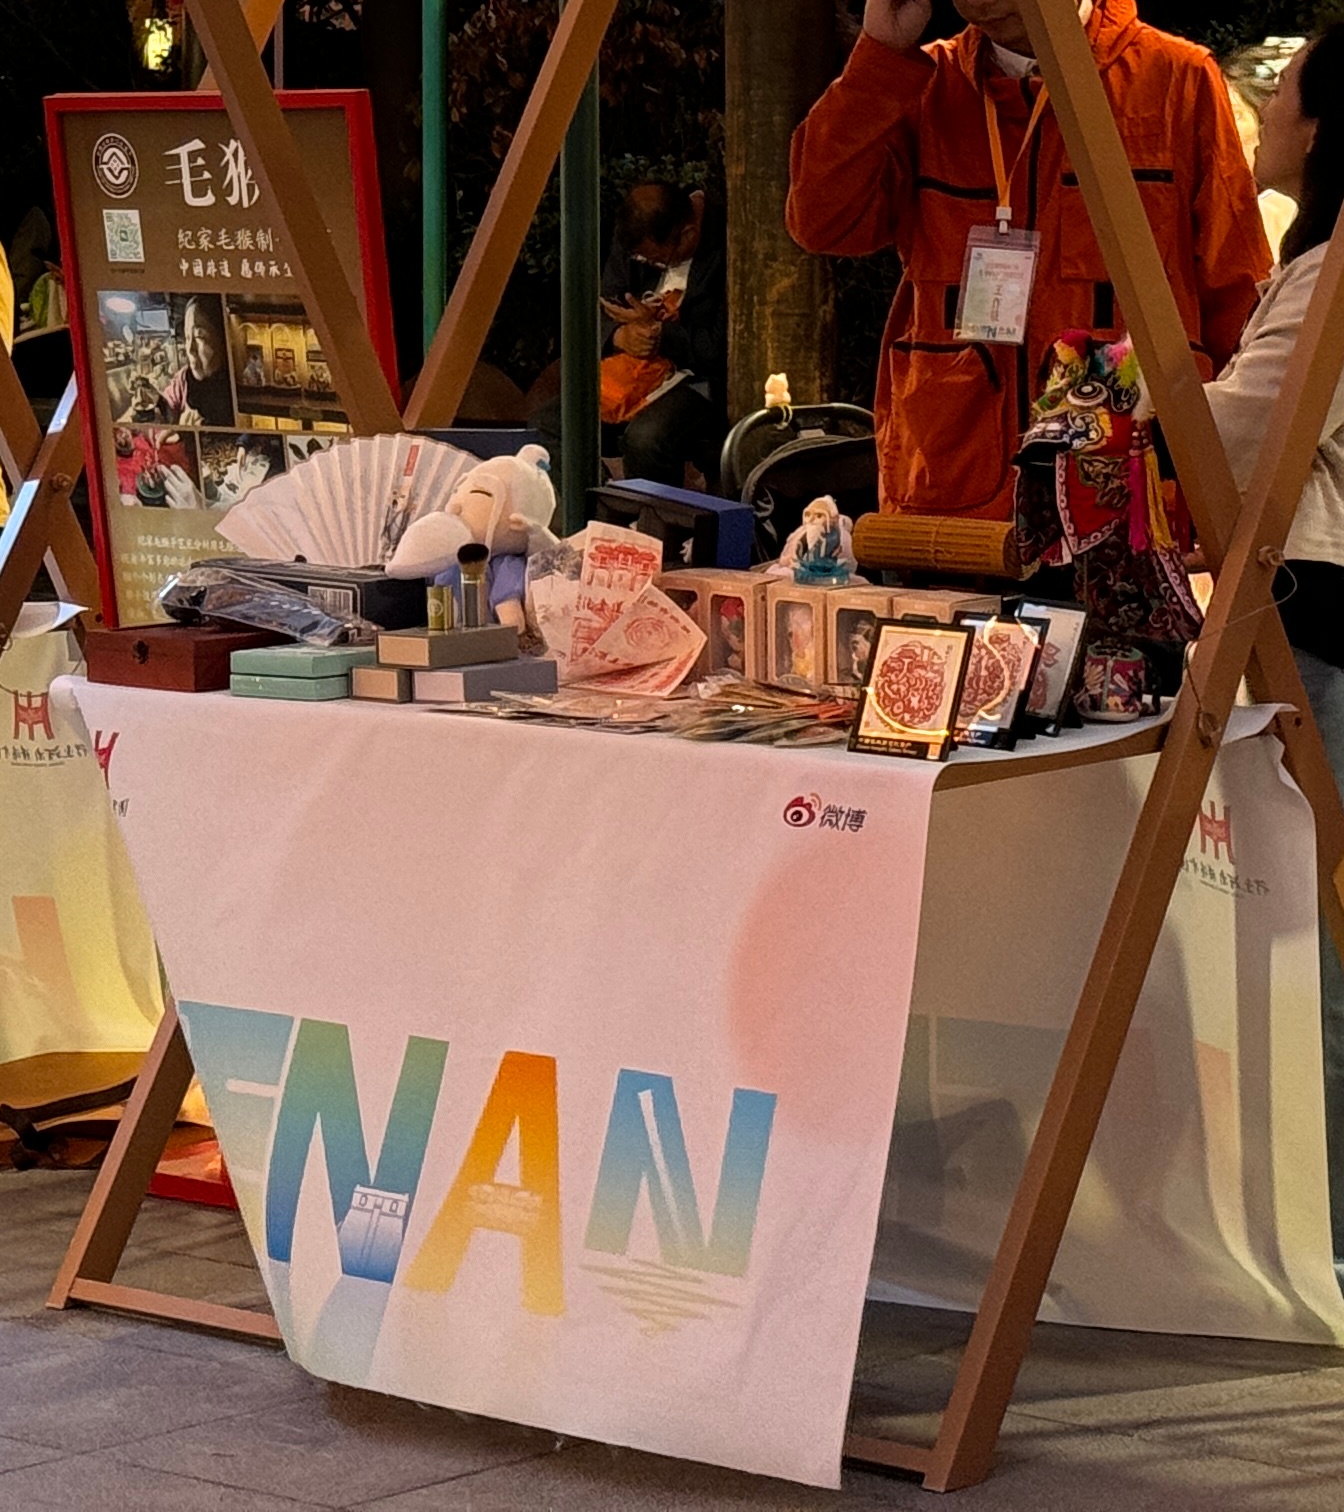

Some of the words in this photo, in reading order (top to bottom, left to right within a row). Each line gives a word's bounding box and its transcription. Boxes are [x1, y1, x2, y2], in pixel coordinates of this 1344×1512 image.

[177, 227, 280, 252] 纪家毛猴制
[819, 804, 868, 832] 微博
